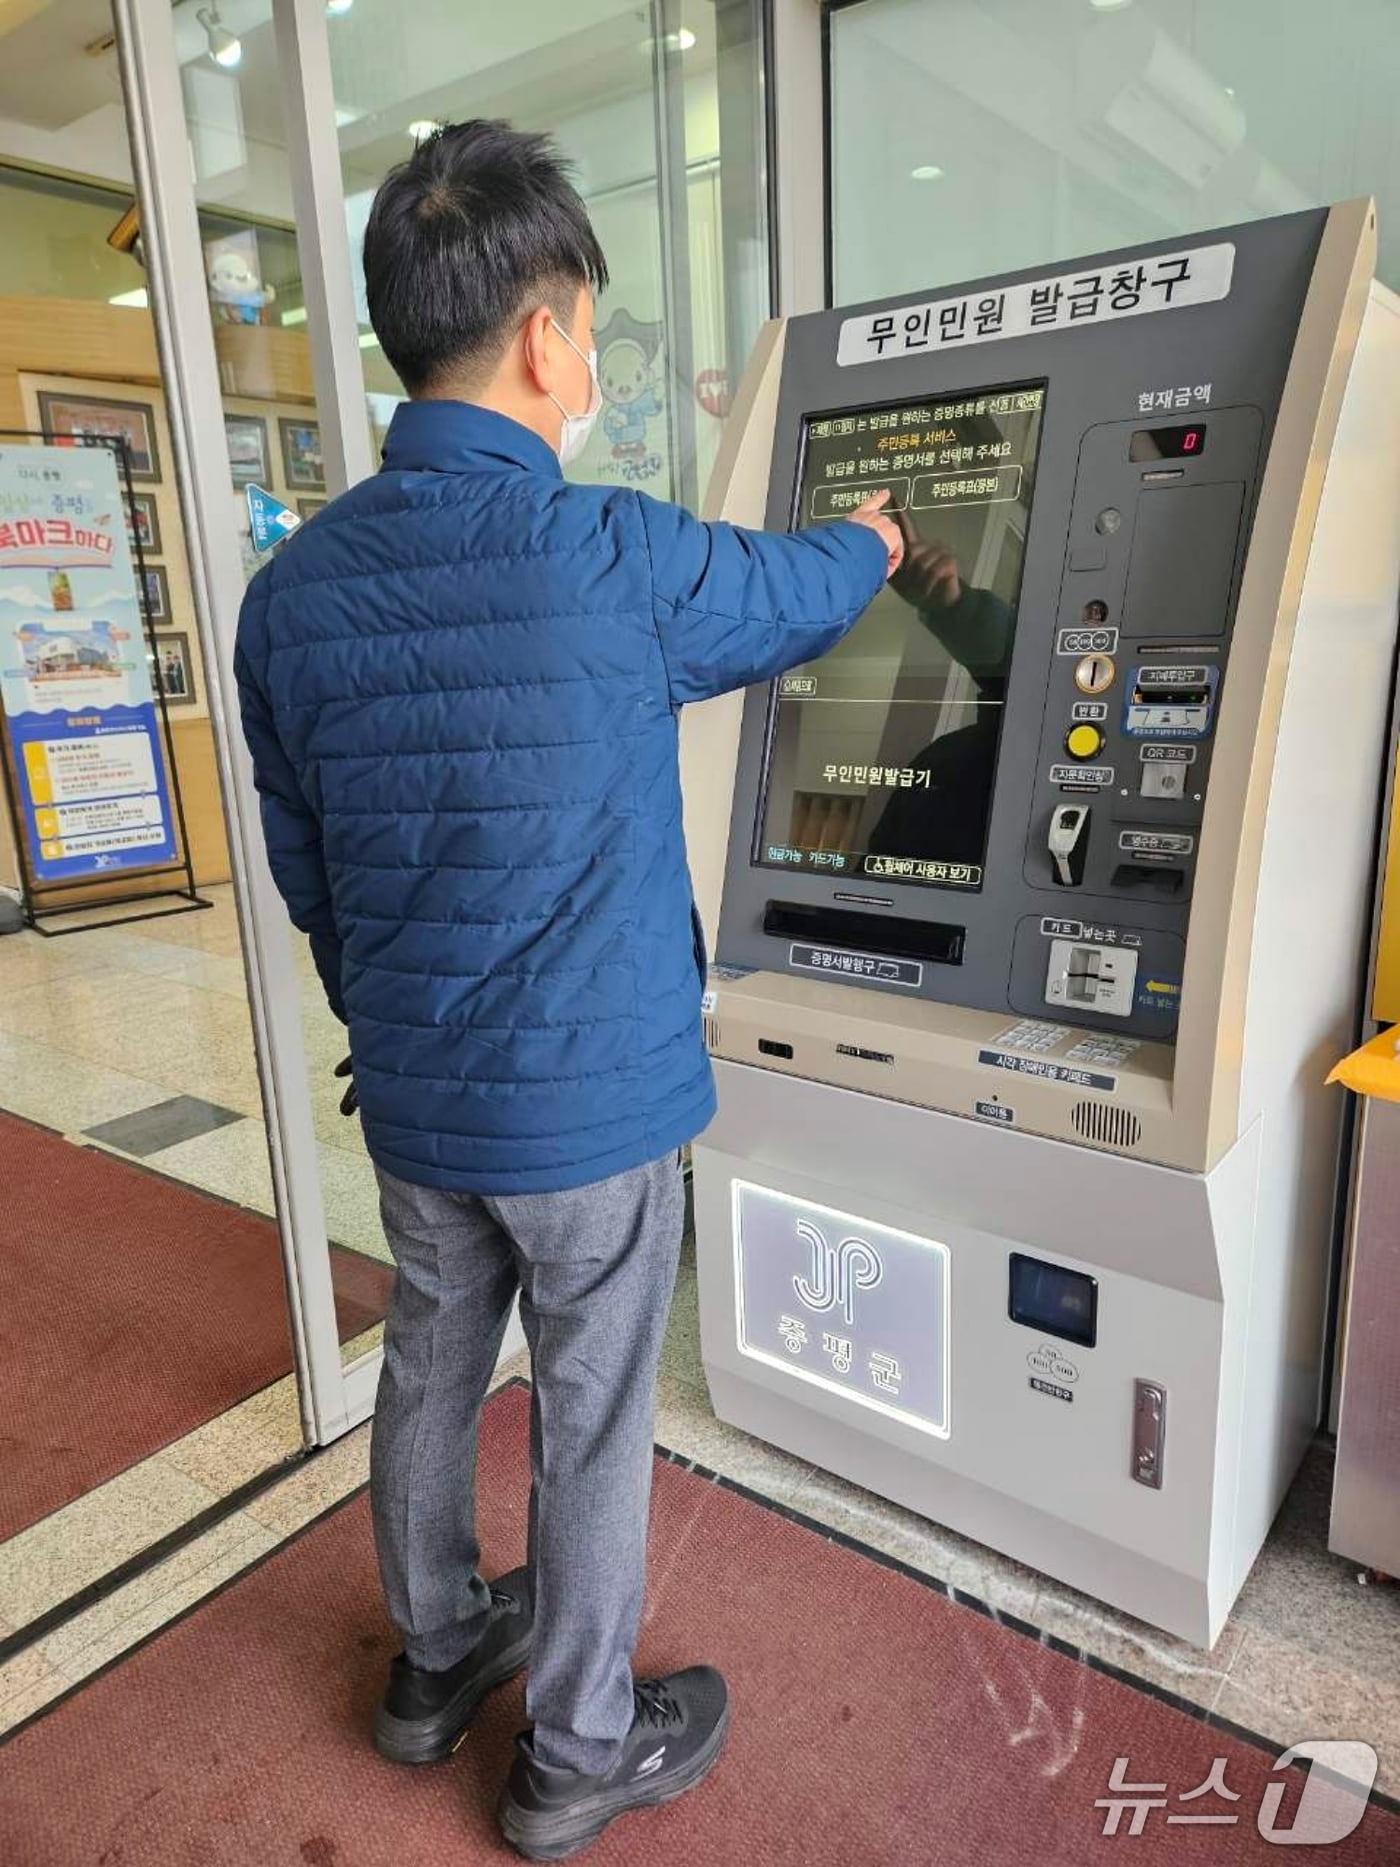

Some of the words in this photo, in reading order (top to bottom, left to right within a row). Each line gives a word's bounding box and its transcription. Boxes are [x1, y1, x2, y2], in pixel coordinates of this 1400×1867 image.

[867, 294, 1005, 353] 무인민원
[1029, 257, 1191, 326] 발급창구
[1139, 384, 1212, 411] 현재금액
[870, 413, 898, 430] 발급을
[902, 409, 931, 425] 원하는
[877, 433, 920, 451] 주민등록
[923, 428, 956, 445] 서비스
[1184, 433, 1196, 449] 0
[826, 460, 855, 477] 발급을
[859, 457, 888, 473] 원하는
[893, 451, 935, 470] 증명서를
[939, 446, 973, 464] 선택해
[977, 441, 1011, 459] 주세요
[1147, 748, 1164, 758] QR
[1167, 749, 1187, 759] 코드
[822, 765, 931, 788] 무인민원발급기
[768, 847, 802, 862] 현금가능
[809, 851, 845, 867] 카드가능
[885, 860, 914, 875] 휠체어
[916, 864, 947, 878] 사용자
[950, 867, 970, 881] 보기
[1051, 923, 1073, 933] 카드
[811, 952, 875, 973] 증명서발행구
[996, 1055, 1017, 1070] 시각
[1061, 1069, 1093, 1085] 키패드
